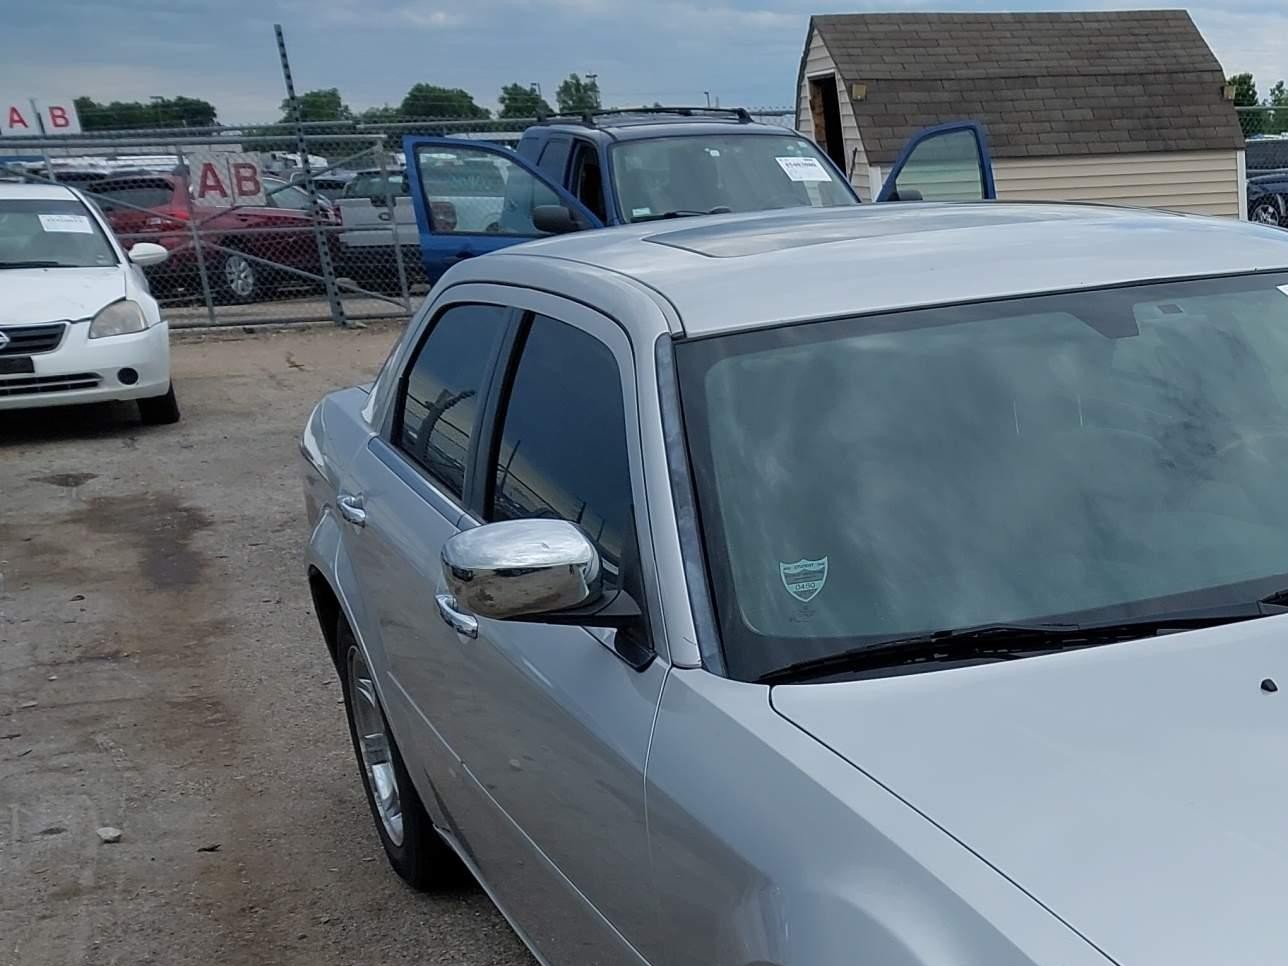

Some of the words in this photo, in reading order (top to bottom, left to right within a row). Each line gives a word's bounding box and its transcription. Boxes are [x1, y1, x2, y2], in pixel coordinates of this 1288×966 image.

[9, 106, 28, 128] A
[48, 106, 70, 128] B
[199, 162, 228, 199] A
[234, 161, 262, 197] B
